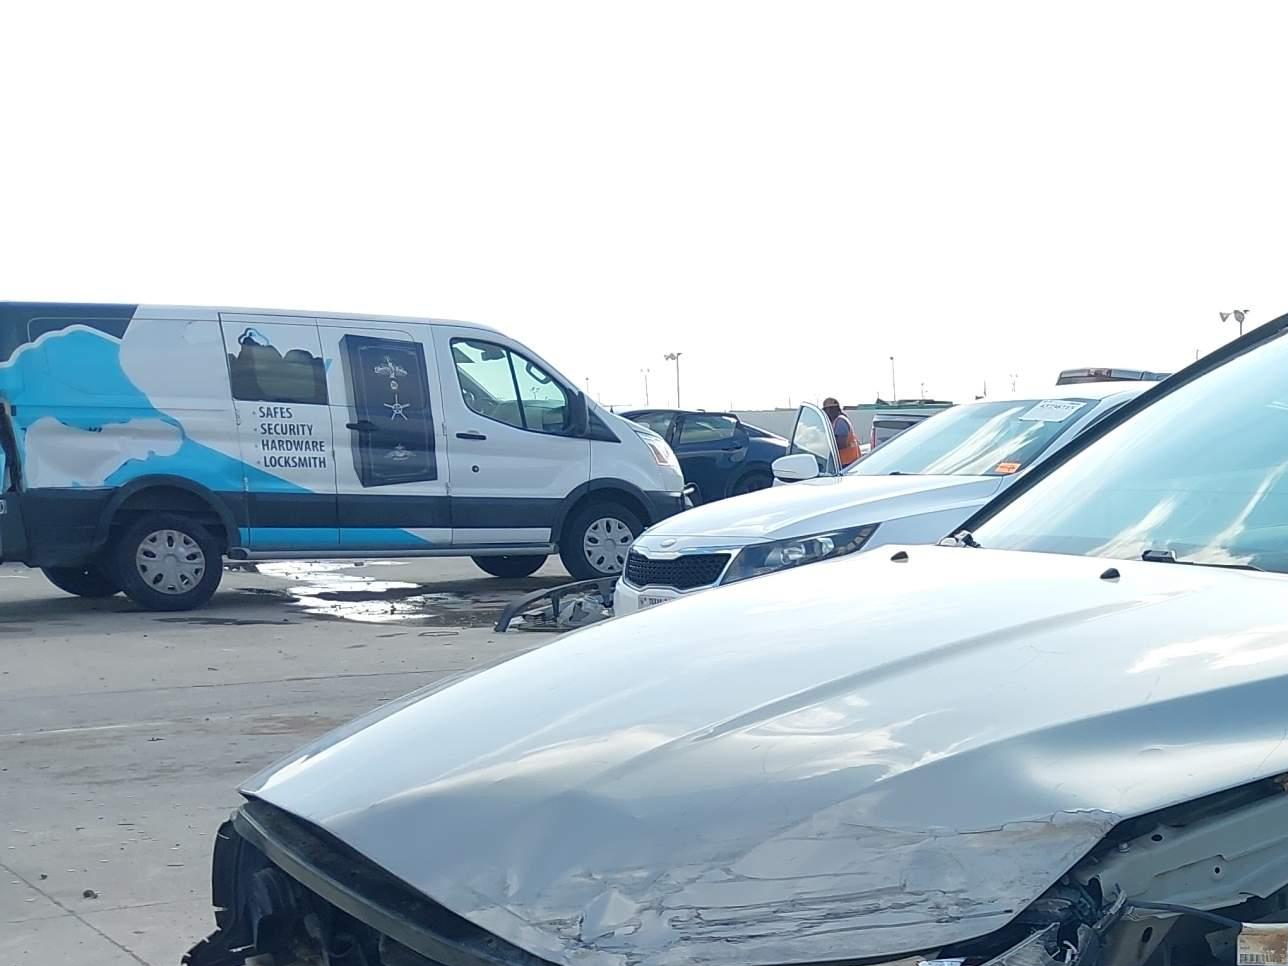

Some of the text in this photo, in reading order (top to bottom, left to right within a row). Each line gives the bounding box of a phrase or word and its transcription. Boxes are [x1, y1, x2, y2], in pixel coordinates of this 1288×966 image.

[258, 406, 293, 419] SAFES
[260, 422, 313, 436] SECURITY
[261, 439, 326, 453] HARDWARE
[263, 455, 327, 469] LOCKSMITH
